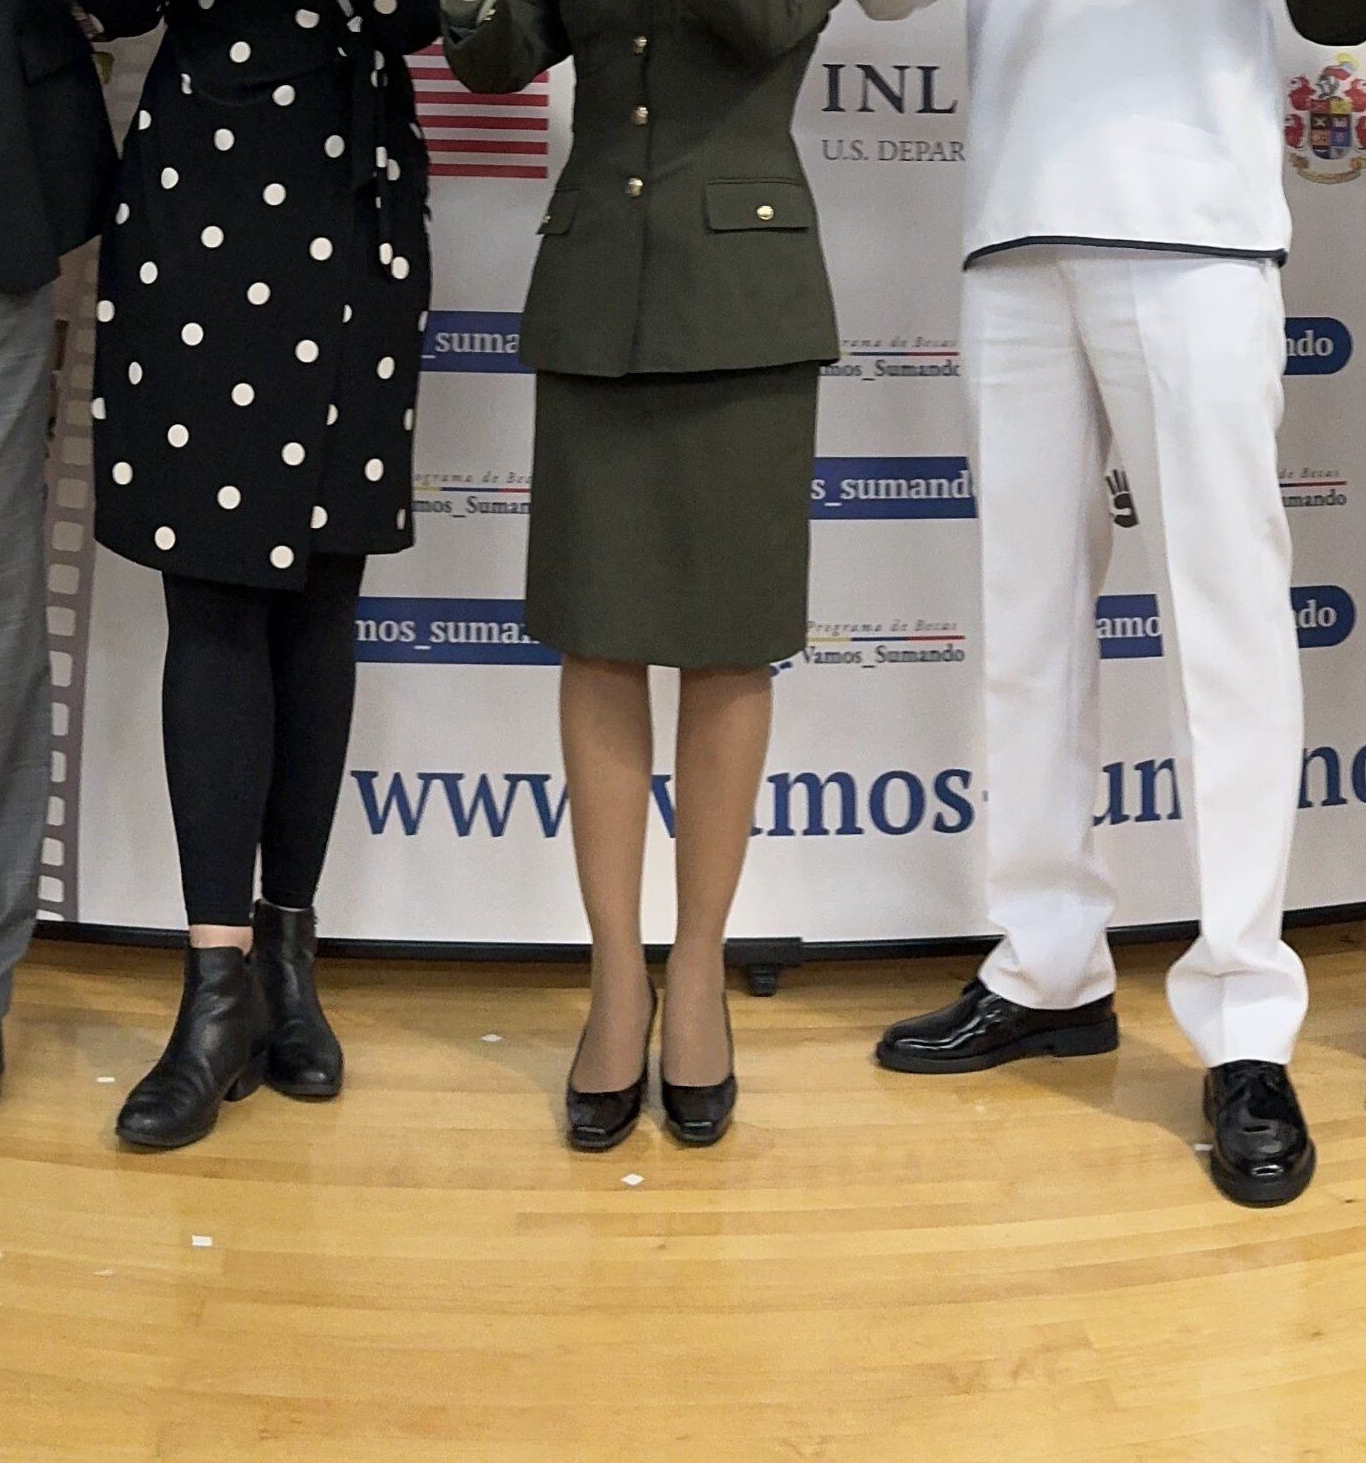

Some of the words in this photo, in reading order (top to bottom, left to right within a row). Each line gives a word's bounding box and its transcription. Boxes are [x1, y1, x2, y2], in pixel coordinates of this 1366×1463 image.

[821, 63, 958, 114] INL
[822, 139, 869, 161] U.S.
[877, 140, 966, 162] DEPAR
[810, 469, 971, 507] s_sumand
[412, 495, 531, 518] mos_Suman
[807, 620, 883, 637] Programa
[889, 619, 909, 632] de
[914, 619, 958, 632] Becas
[803, 643, 966, 669] Vamos_Sumando
